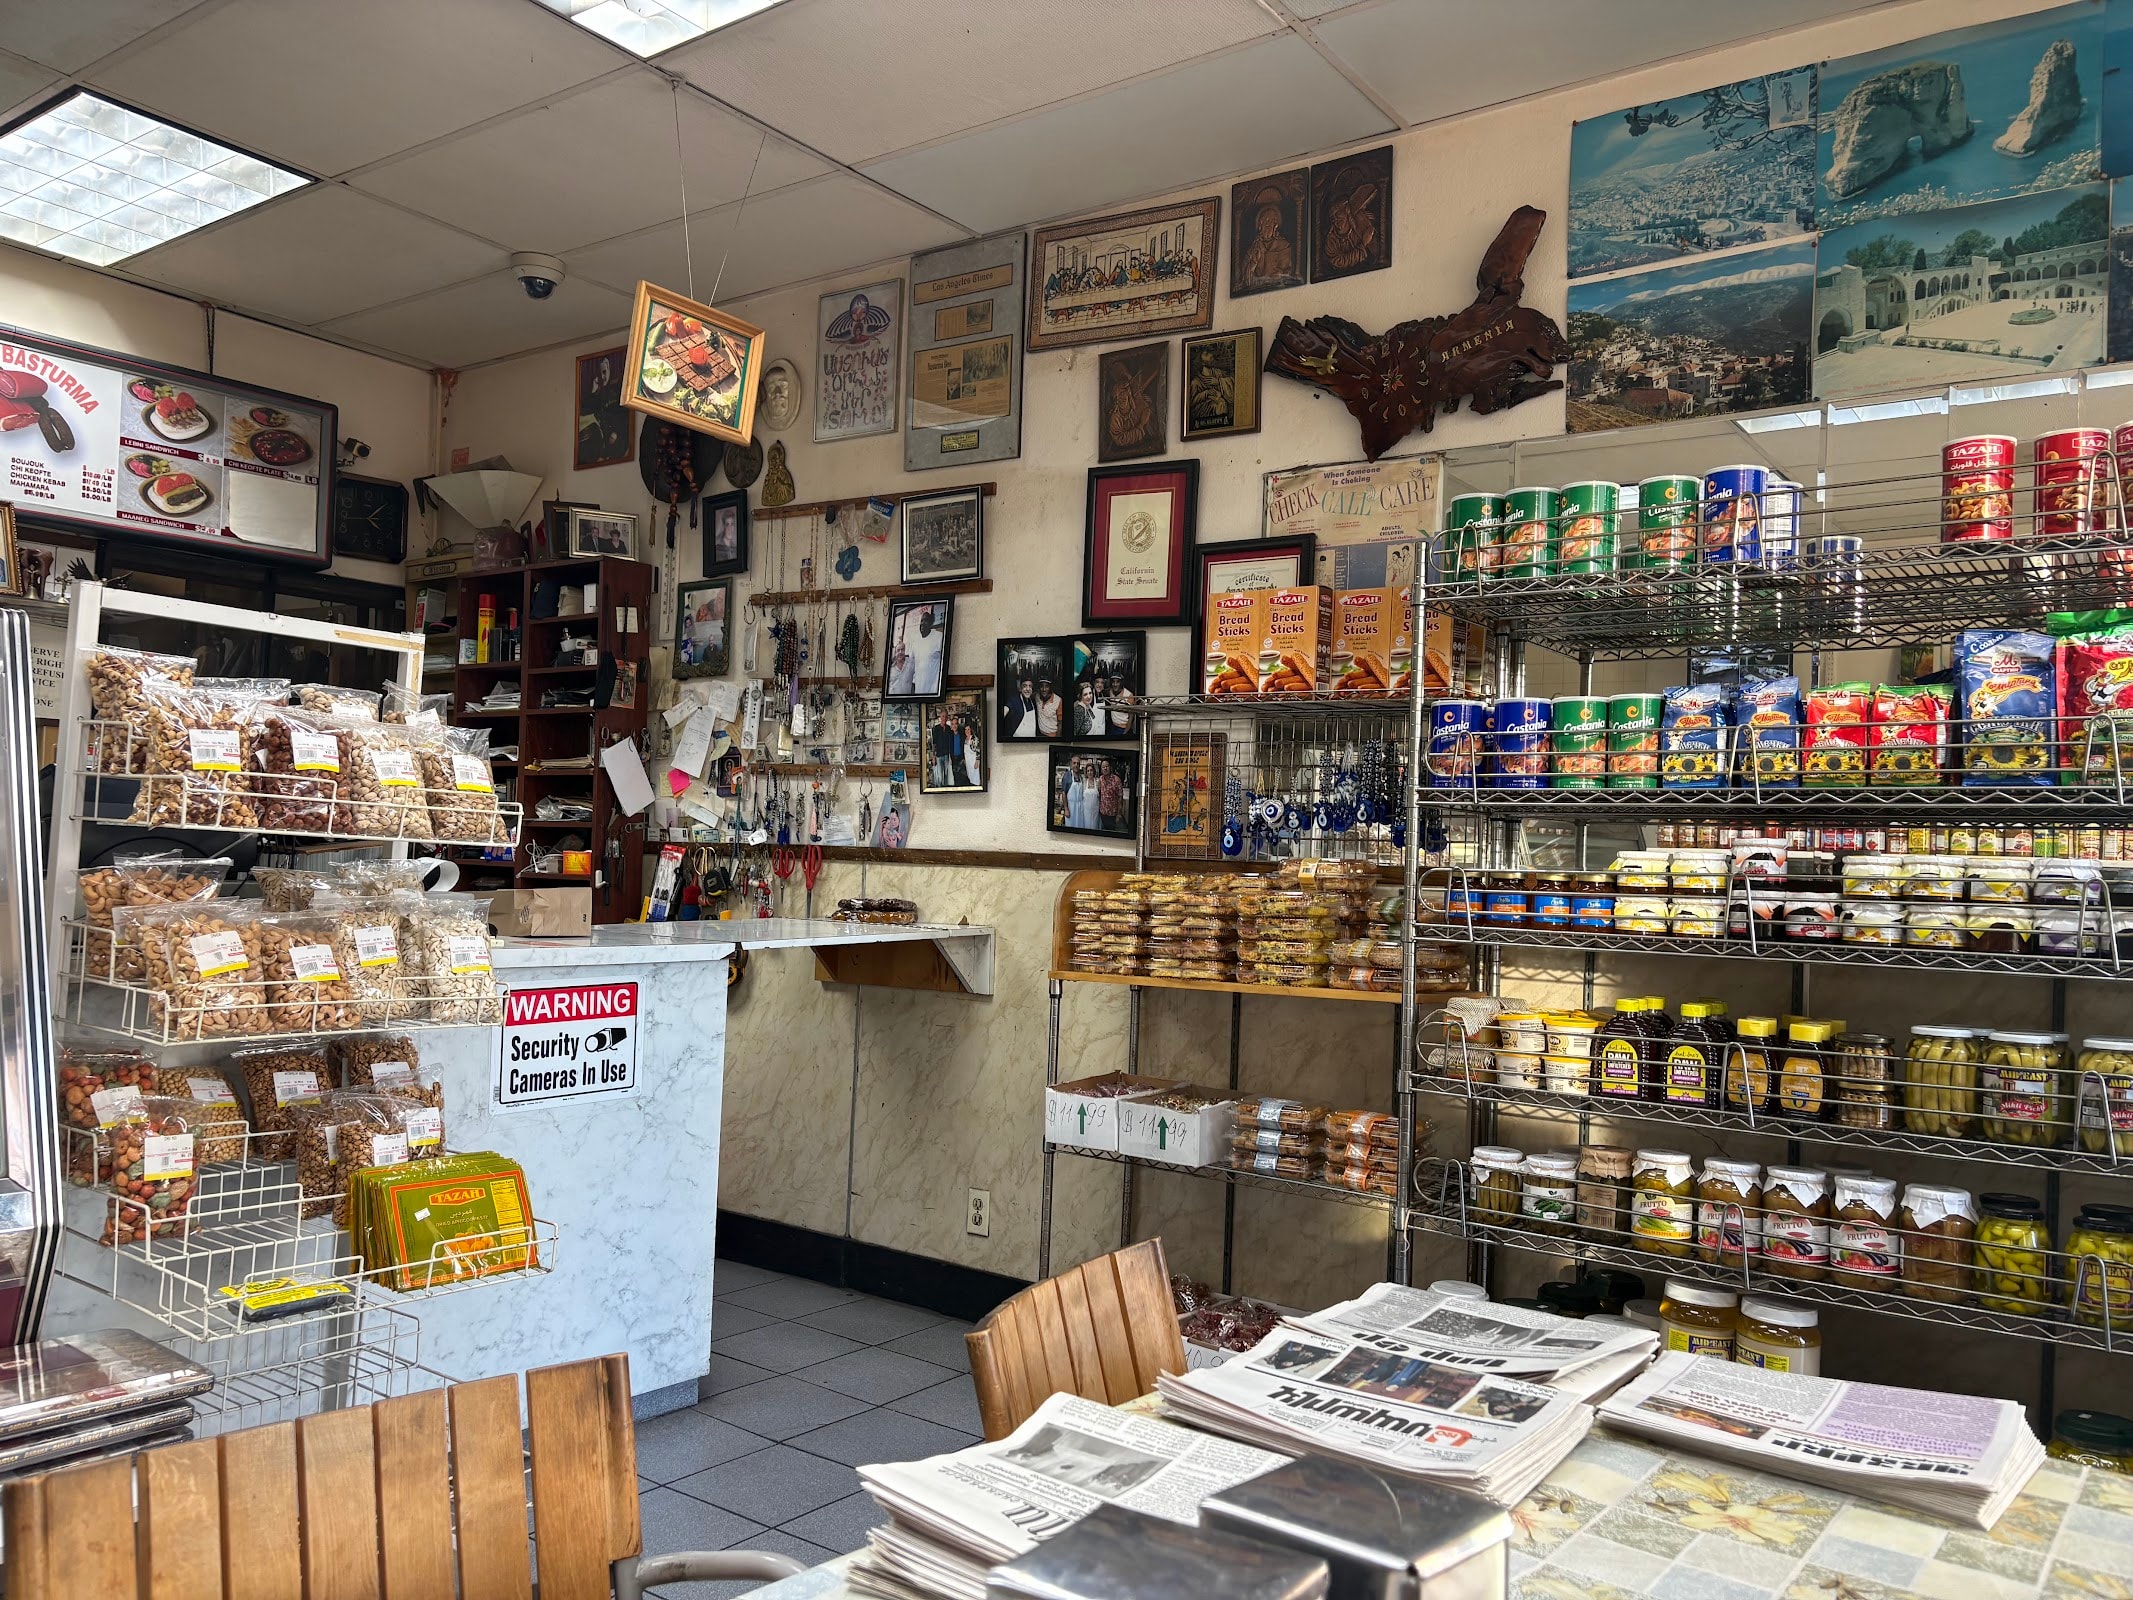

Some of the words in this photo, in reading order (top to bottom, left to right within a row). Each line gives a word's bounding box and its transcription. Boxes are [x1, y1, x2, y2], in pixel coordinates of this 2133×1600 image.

[932, 283, 944, 292] Los
[945, 277, 971, 289] Angeles
[972, 272, 993, 283] Times
[1441, 319, 1514, 363] ARMENIA
[2, 345, 99, 414] BASTURMA
[2080, 437, 2107, 448] TAZ
[145, 443, 179, 456] SANDWICH
[1950, 444, 1998, 457] TAZAH
[11, 457, 45, 469] SOUJOUK
[10, 472, 41, 482] CHICKEN
[263, 467, 281, 477] PLATE
[1346, 467, 1381, 476] Someone
[10, 479, 50, 491] MAHAMARA
[1341, 476, 1371, 485] Choking
[1269, 484, 1319, 525] CHECK
[1321, 489, 1372, 516] CALL
[1380, 476, 1435, 511] CARE
[150, 517, 185, 529] SANDWICH
[1120, 567, 1155, 575] California
[1117, 578, 1135, 586] State
[1136, 577, 1158, 586] Senate
[1220, 599, 1251, 608] TAZAH
[1273, 595, 1306, 604] TAZAH
[1219, 614, 1250, 625] Bread
[1272, 612, 1304, 623] Bread
[1345, 612, 1378, 623] Bread
[1218, 626, 1250, 637] Sticks
[1270, 624, 1304, 635] Sticks
[1343, 625, 1378, 635] Sticks
[36, 658, 65, 669] RIGH
[1433, 720, 1469, 737] Castania
[1507, 719, 1547, 734] Castania
[1564, 718, 1605, 735] Castania
[1613, 716, 1655, 734] Castania
[511, 989, 631, 1021] WARNING
[511, 1032, 579, 1061] Security
[509, 1068, 577, 1095] Cameras
[582, 1062, 596, 1085] In
[601, 1059, 627, 1084] Use
[434, 1189, 480, 1204] TAZAH
[1640, 1200, 1667, 1208] FRUTTO
[1847, 1232, 1880, 1240] FRUTTO
